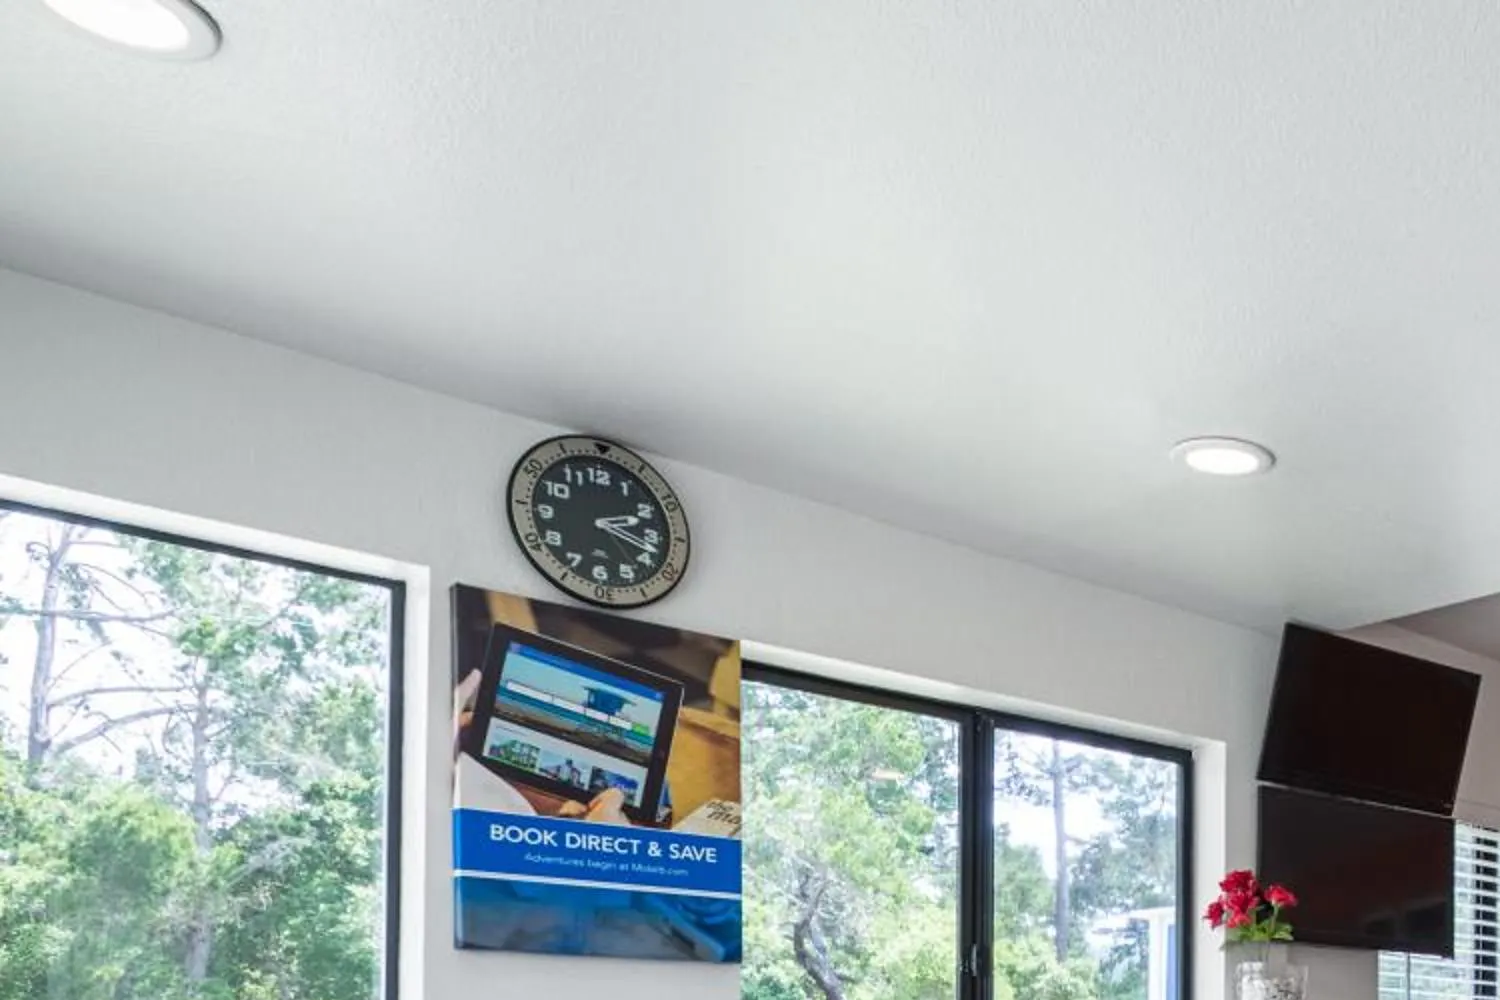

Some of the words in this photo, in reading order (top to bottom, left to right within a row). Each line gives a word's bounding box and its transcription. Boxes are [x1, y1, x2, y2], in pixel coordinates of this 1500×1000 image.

[564, 464, 584, 486] 11
[587, 467, 611, 486] 12
[544, 481, 570, 499] 10
[620, 482, 630, 497] 1
[537, 504, 554, 519] 9
[637, 503, 653, 519] 2
[545, 531, 562, 546] 8
[644, 529, 660, 545] 3
[566, 552, 582, 567] 7
[636, 552, 652, 566] 4
[592, 565, 608, 580] 6
[619, 564, 635, 579] 5
[490, 823, 558, 848] BOOK
[565, 832, 642, 855] DIRECT
[647, 841, 662, 857] &
[669, 843, 718, 863] SAVE
